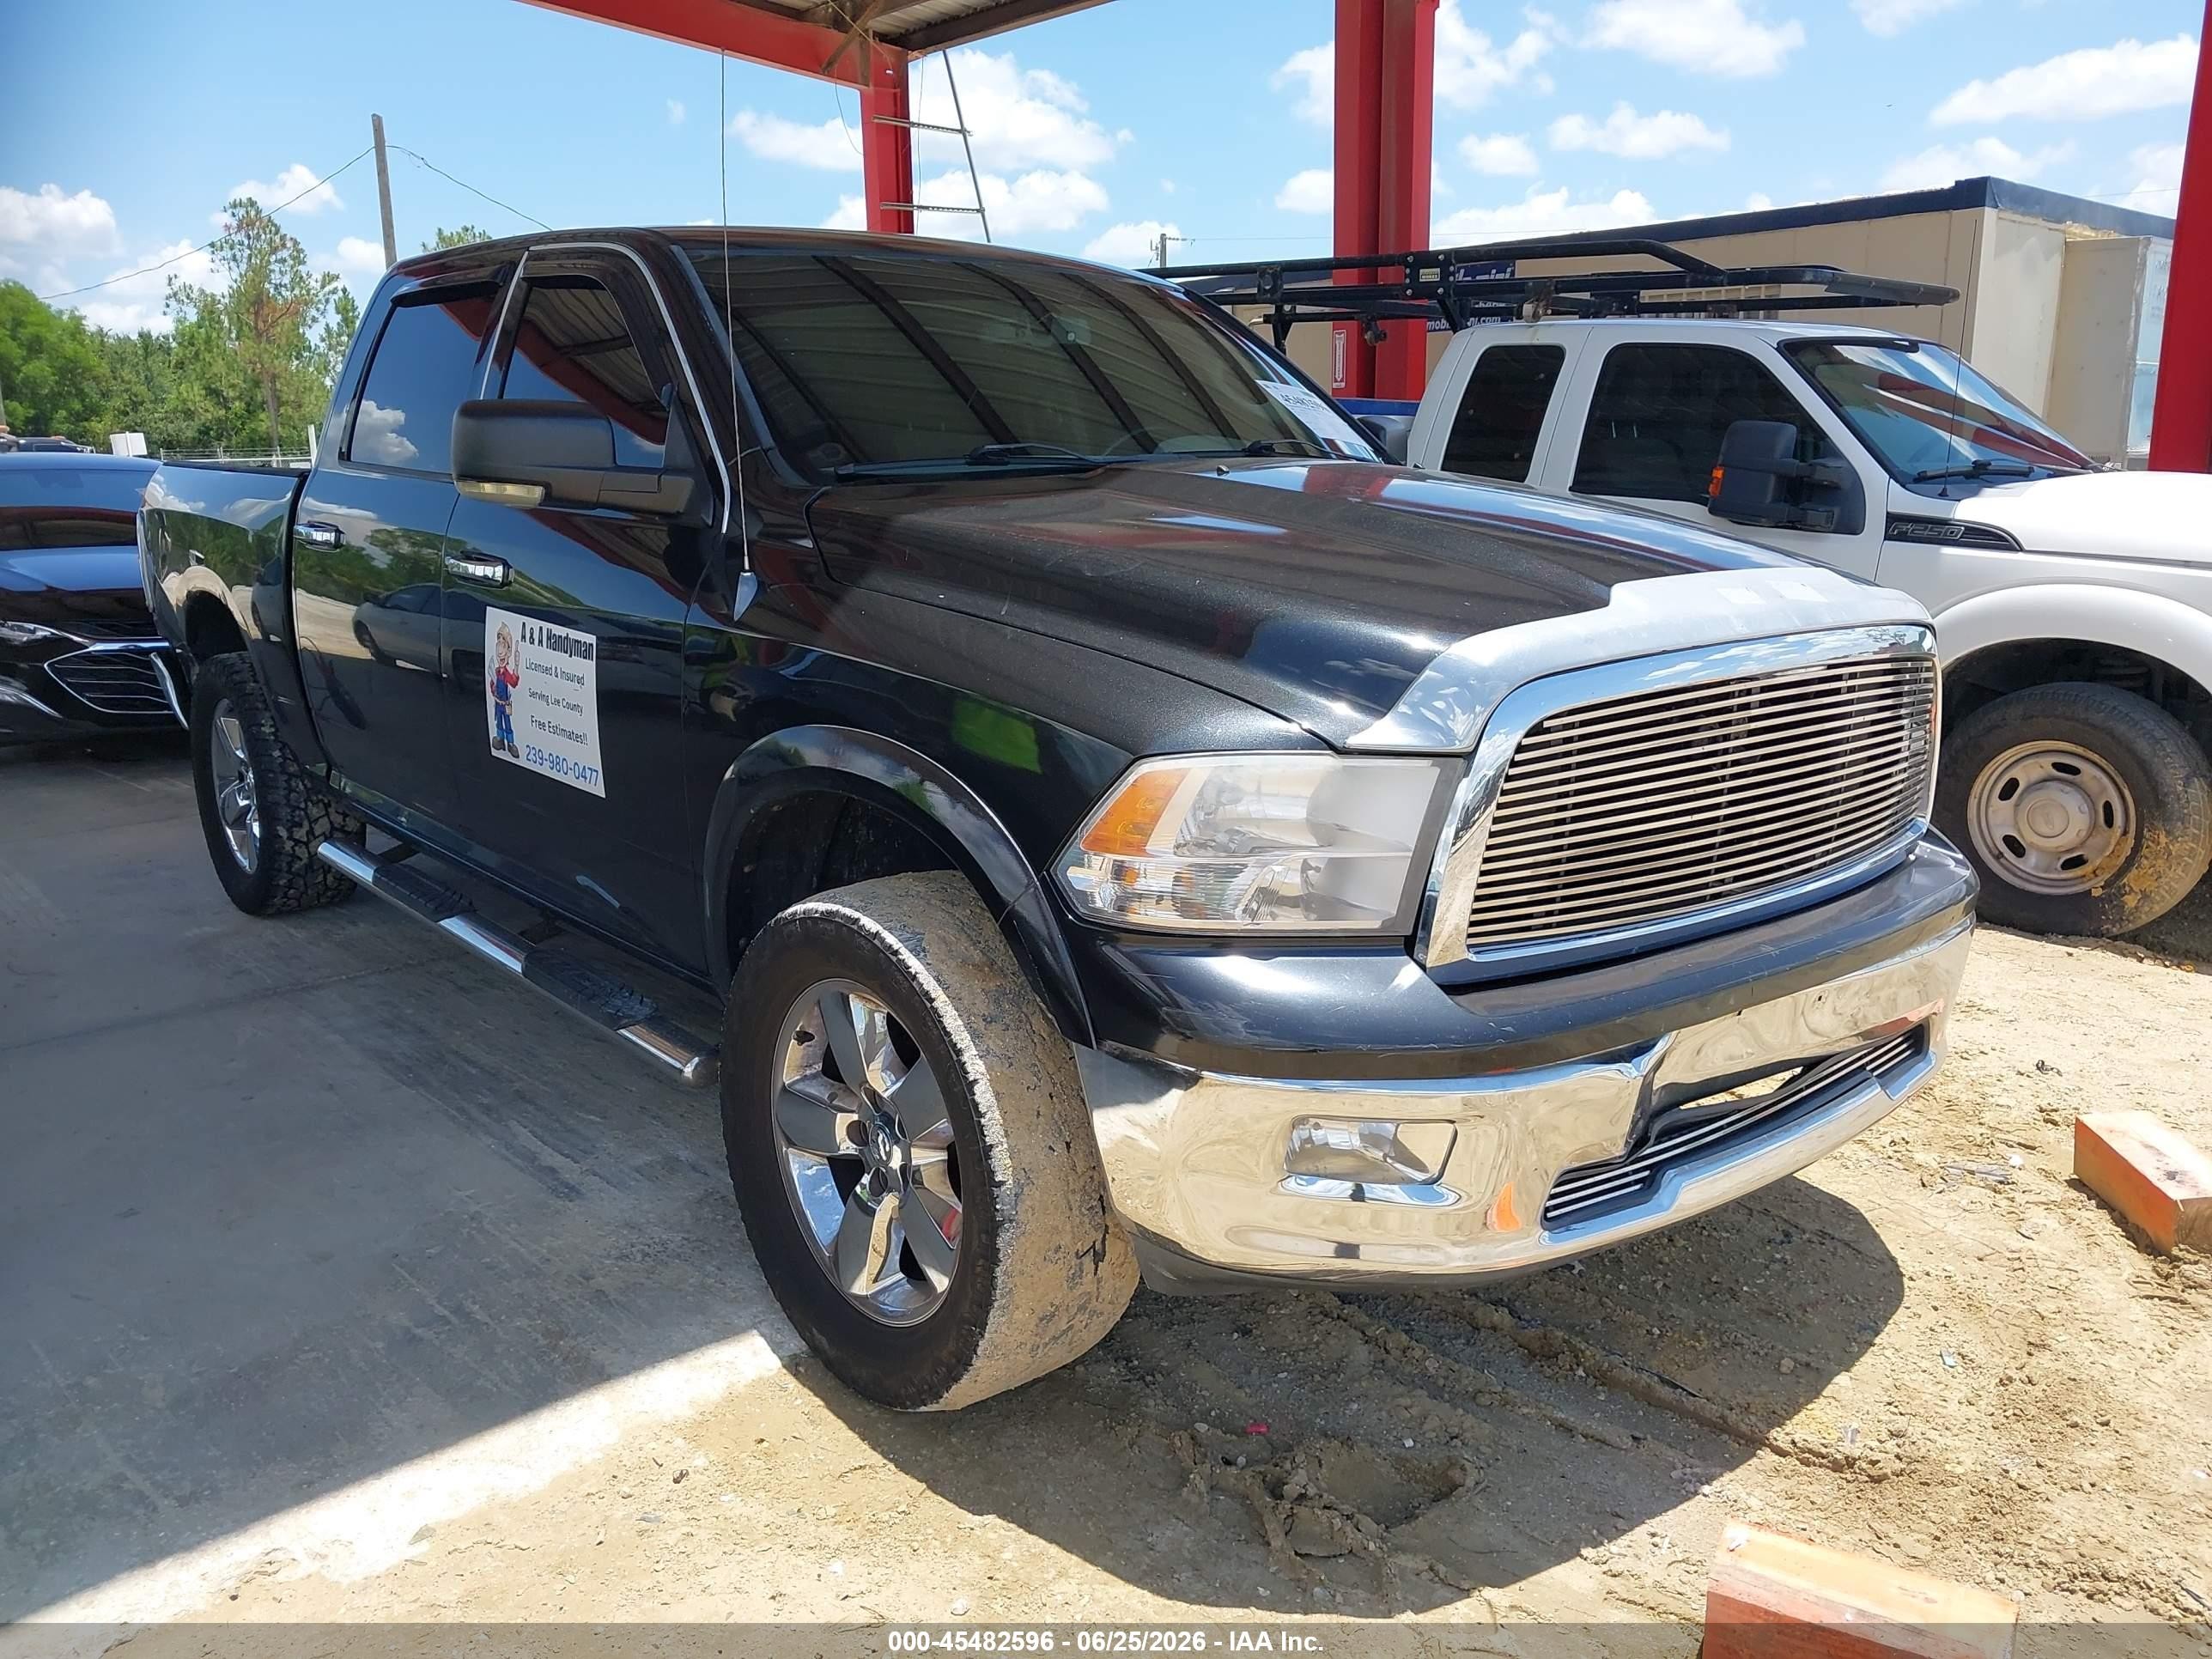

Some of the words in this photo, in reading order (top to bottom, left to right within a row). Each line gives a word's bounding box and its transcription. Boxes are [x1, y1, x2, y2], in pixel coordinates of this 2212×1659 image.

[521, 622, 526, 643] A
[529, 626, 535, 647] &
[538, 627, 544, 647] A
[546, 628, 594, 661] Handyman
[526, 658, 552, 676] Licensed
[554, 666, 559, 677] &
[560, 669, 585, 686] Insured
[528, 687, 550, 706] Serving
[550, 696, 561, 708] Lee
[562, 699, 583, 716] County
[531, 715, 546, 732] Free
[548, 721, 588, 746] Estimates!!
[526, 744, 599, 787] 239-980-0477
